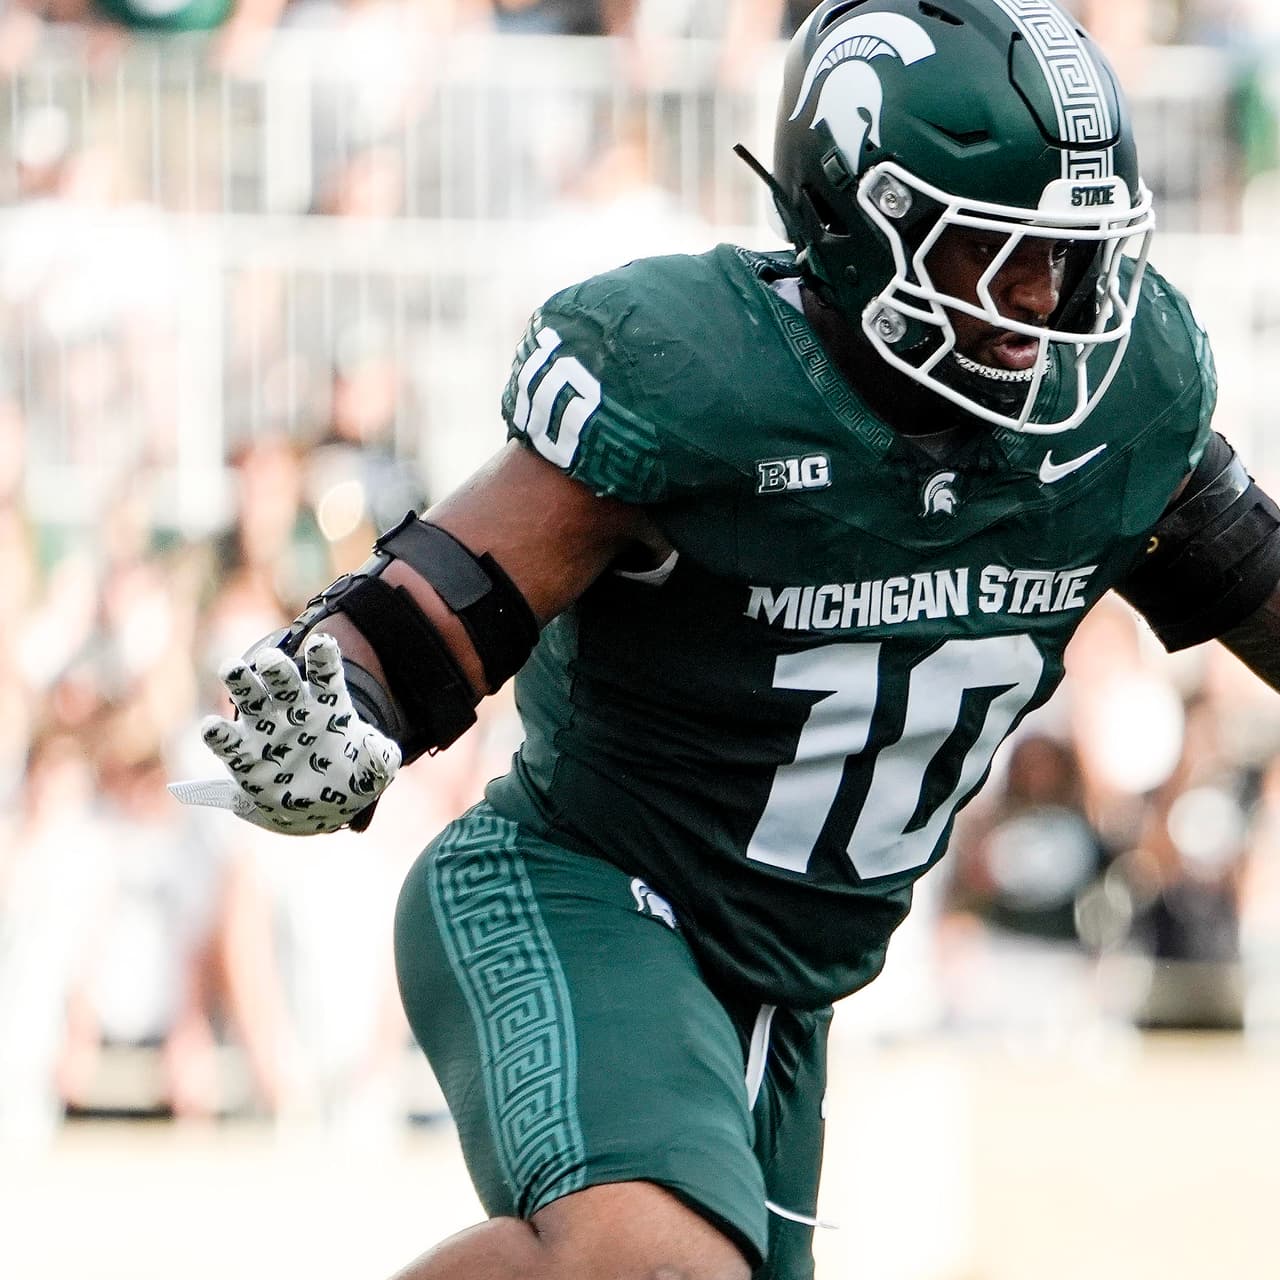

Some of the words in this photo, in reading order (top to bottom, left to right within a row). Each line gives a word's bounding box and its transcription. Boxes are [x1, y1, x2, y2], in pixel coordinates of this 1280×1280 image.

[1071, 185, 1116, 206] STATE
[513, 326, 603, 469] 10
[743, 567, 969, 631] MICHIGAN
[978, 564, 1099, 615] STATE
[745, 633, 1045, 881] 10
